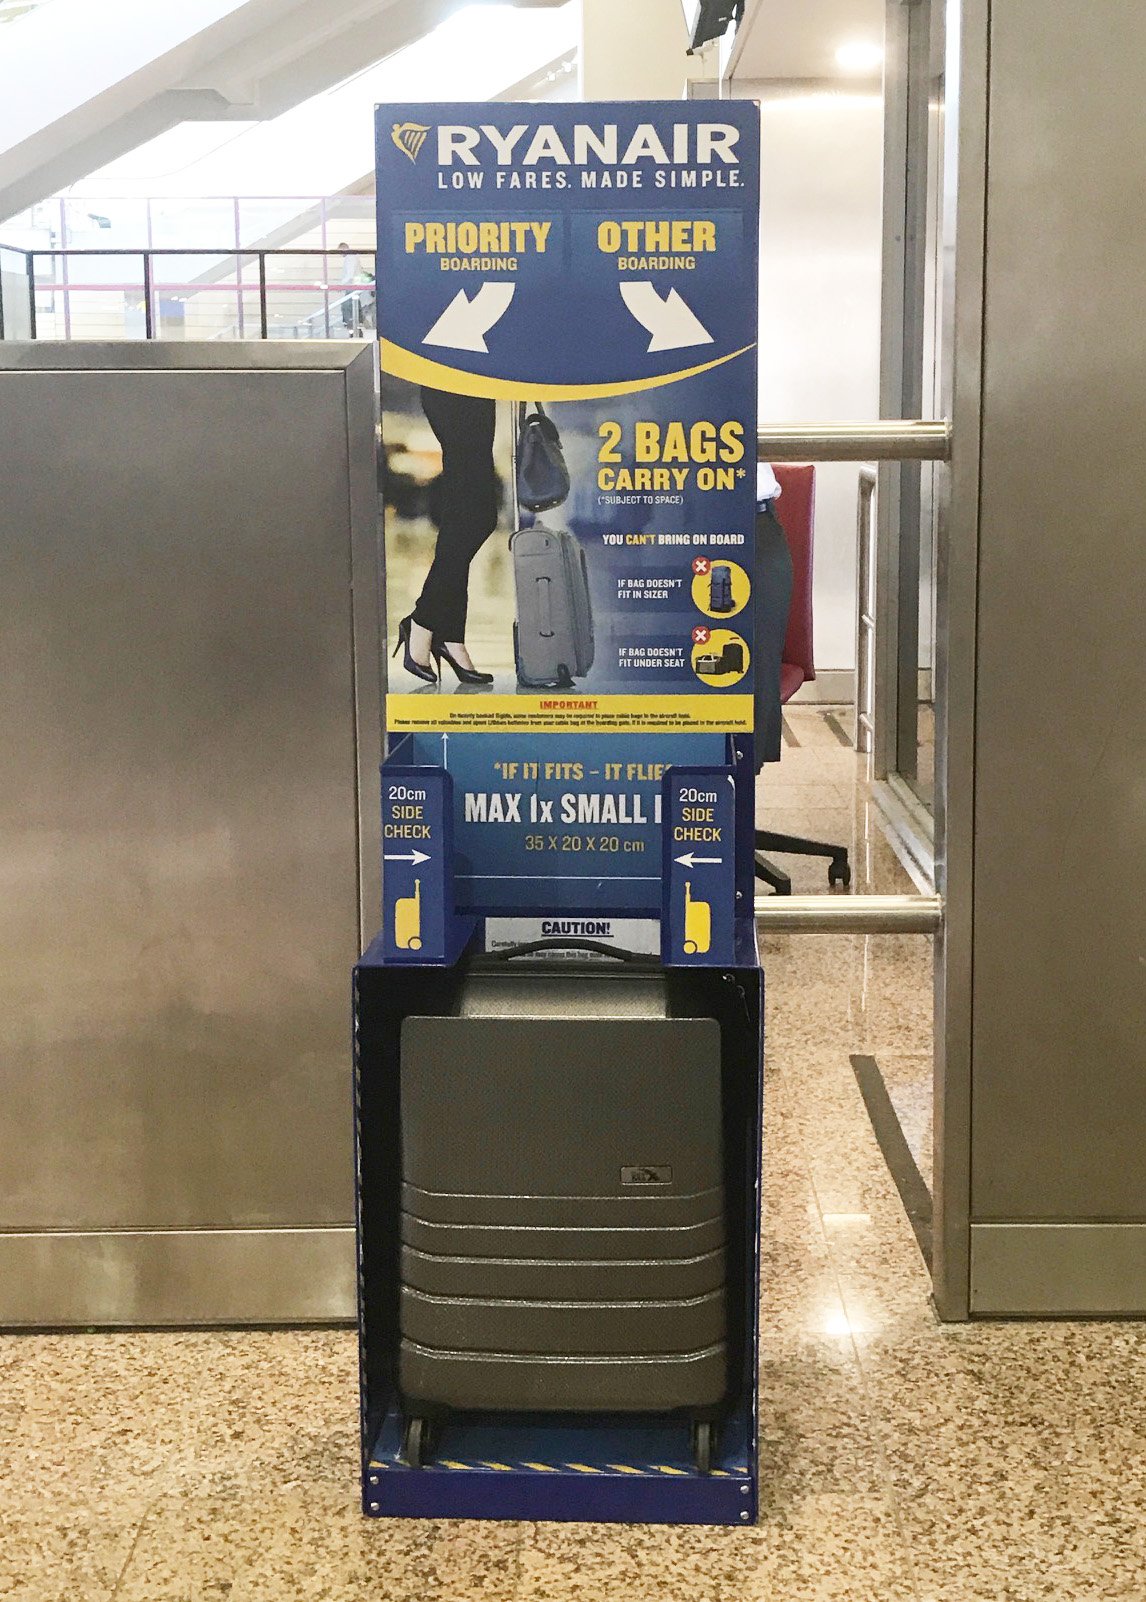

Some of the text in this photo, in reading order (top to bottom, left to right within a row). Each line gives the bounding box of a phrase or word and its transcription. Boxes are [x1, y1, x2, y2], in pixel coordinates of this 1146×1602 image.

[437, 123, 740, 166] RYANAIR
[437, 169, 745, 189] LOW FARES. MADE SIMPLE.
[404, 221, 551, 254] PRIORITY
[597, 220, 717, 253] OTHER
[440, 257, 518, 271] BOARDING
[617, 256, 696, 270] BOARDING
[598, 420, 745, 464] 2 BAGS
[597, 468, 690, 491] CARRY
[643, 495, 653, 504] TO
[655, 495, 684, 505] SPACE)
[602, 534, 745, 545] YOU CAN'T BRING ON BOARD
[618, 579, 683, 588] IF BAG DOESN'T
[618, 590, 669, 599] FIT IN SIZER
[619, 648, 684, 657] IF BAG DOESN'T
[619, 659, 685, 668] FIT UNDER SEAT
[540, 700, 598, 710] IMPORTANT
[523, 762, 540, 780] IT
[545, 762, 584, 781] FITS
[604, 762, 623, 780] IT
[627, 763, 672, 781] FLIE
[389, 786, 426, 801] 20cm
[679, 788, 718, 803] 20cm
[392, 805, 423, 819] SIDE
[464, 793, 523, 824] MAX
[561, 792, 647, 824] SMALL
[682, 808, 714, 822] SIDE
[384, 825, 431, 839] CHECK
[674, 827, 722, 842] CHECK
[525, 835, 544, 850] 35
[562, 835, 582, 851] 20
[599, 836, 619, 852] 20
[623, 839, 645, 852] cm
[541, 921, 611, 935] CAUTION!
